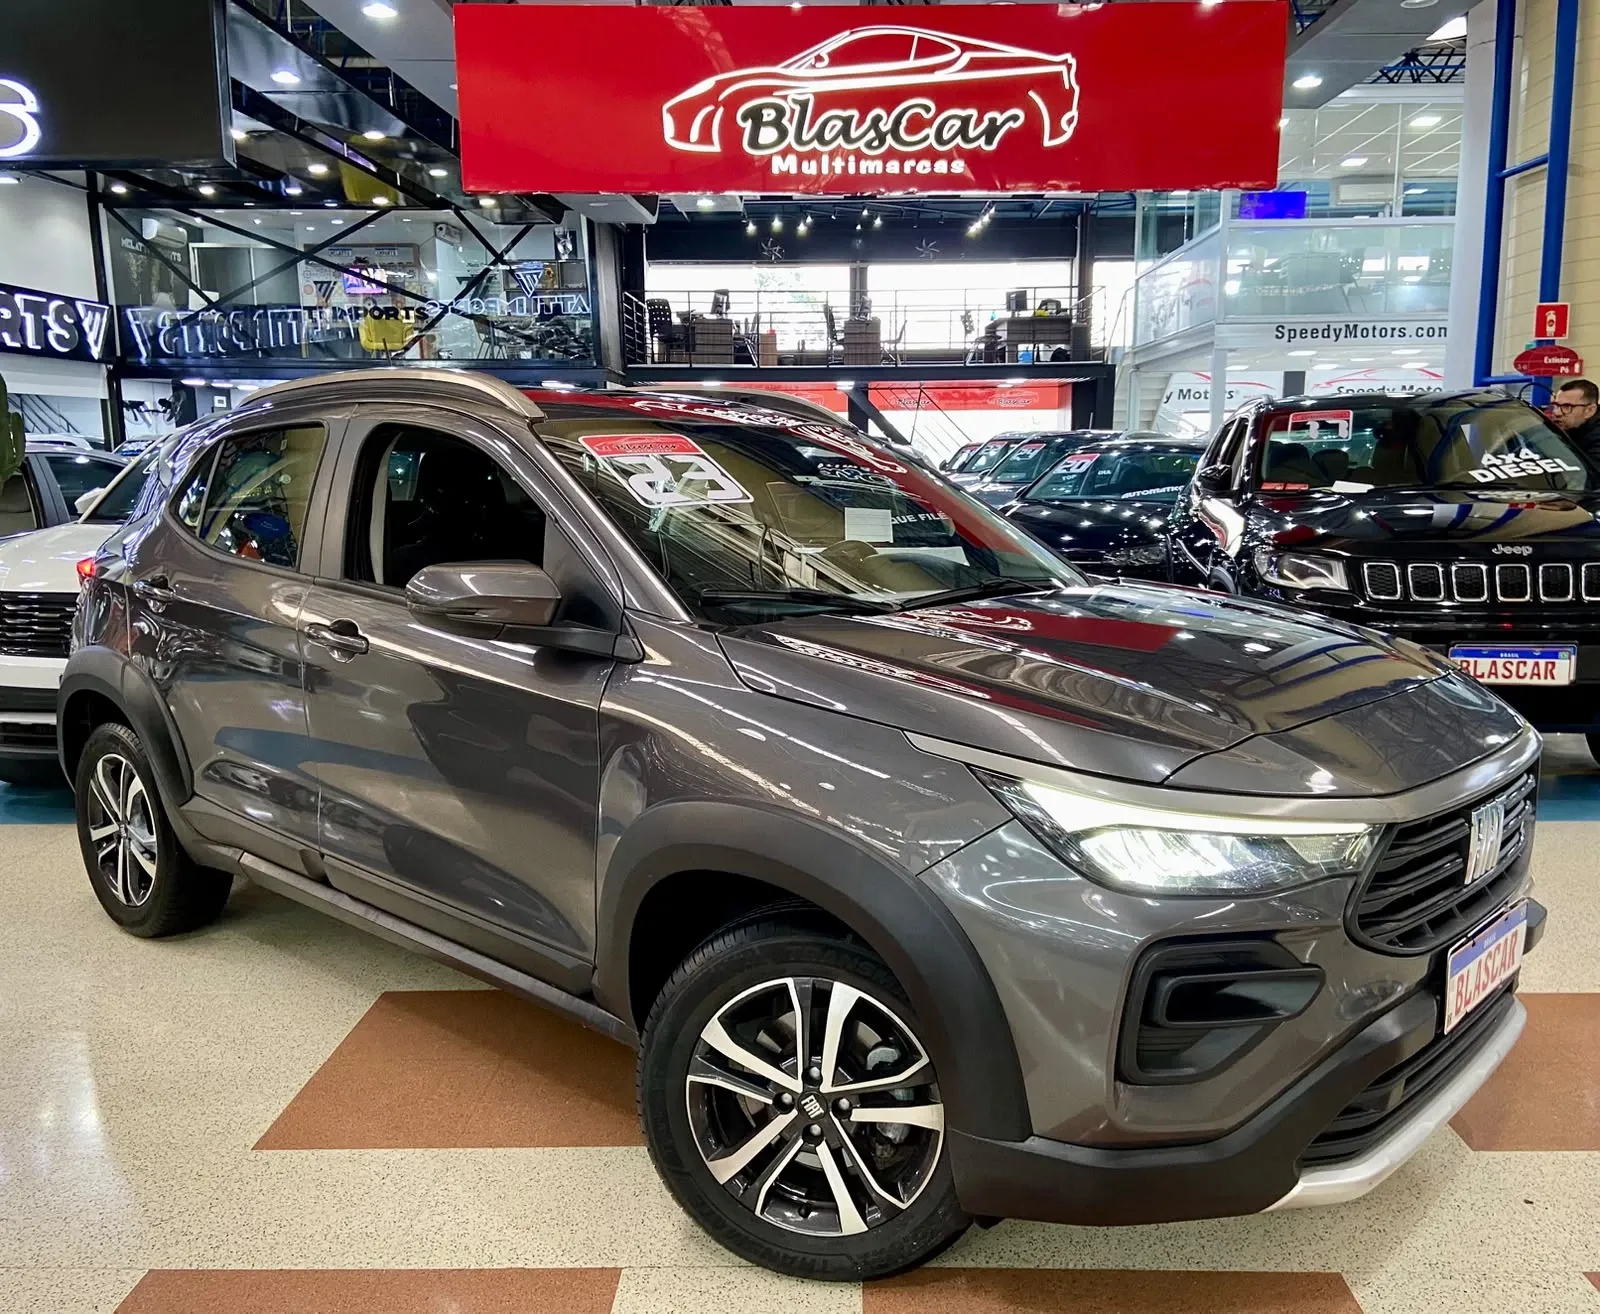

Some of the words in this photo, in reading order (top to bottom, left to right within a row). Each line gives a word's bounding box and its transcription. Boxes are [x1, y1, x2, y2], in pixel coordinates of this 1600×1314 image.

[737, 93, 1025, 156] BlasCar
[771, 154, 966, 176] Multimarcas
[612, 455, 743, 502] 23
[1467, 458, 1581, 484] DIESEL
[1491, 544, 1533, 556] Jeep
[1459, 660, 1556, 681] BLASCAR
[1455, 929, 1518, 1017] BLASCAR
[801, 1095, 825, 1119] FIAT
